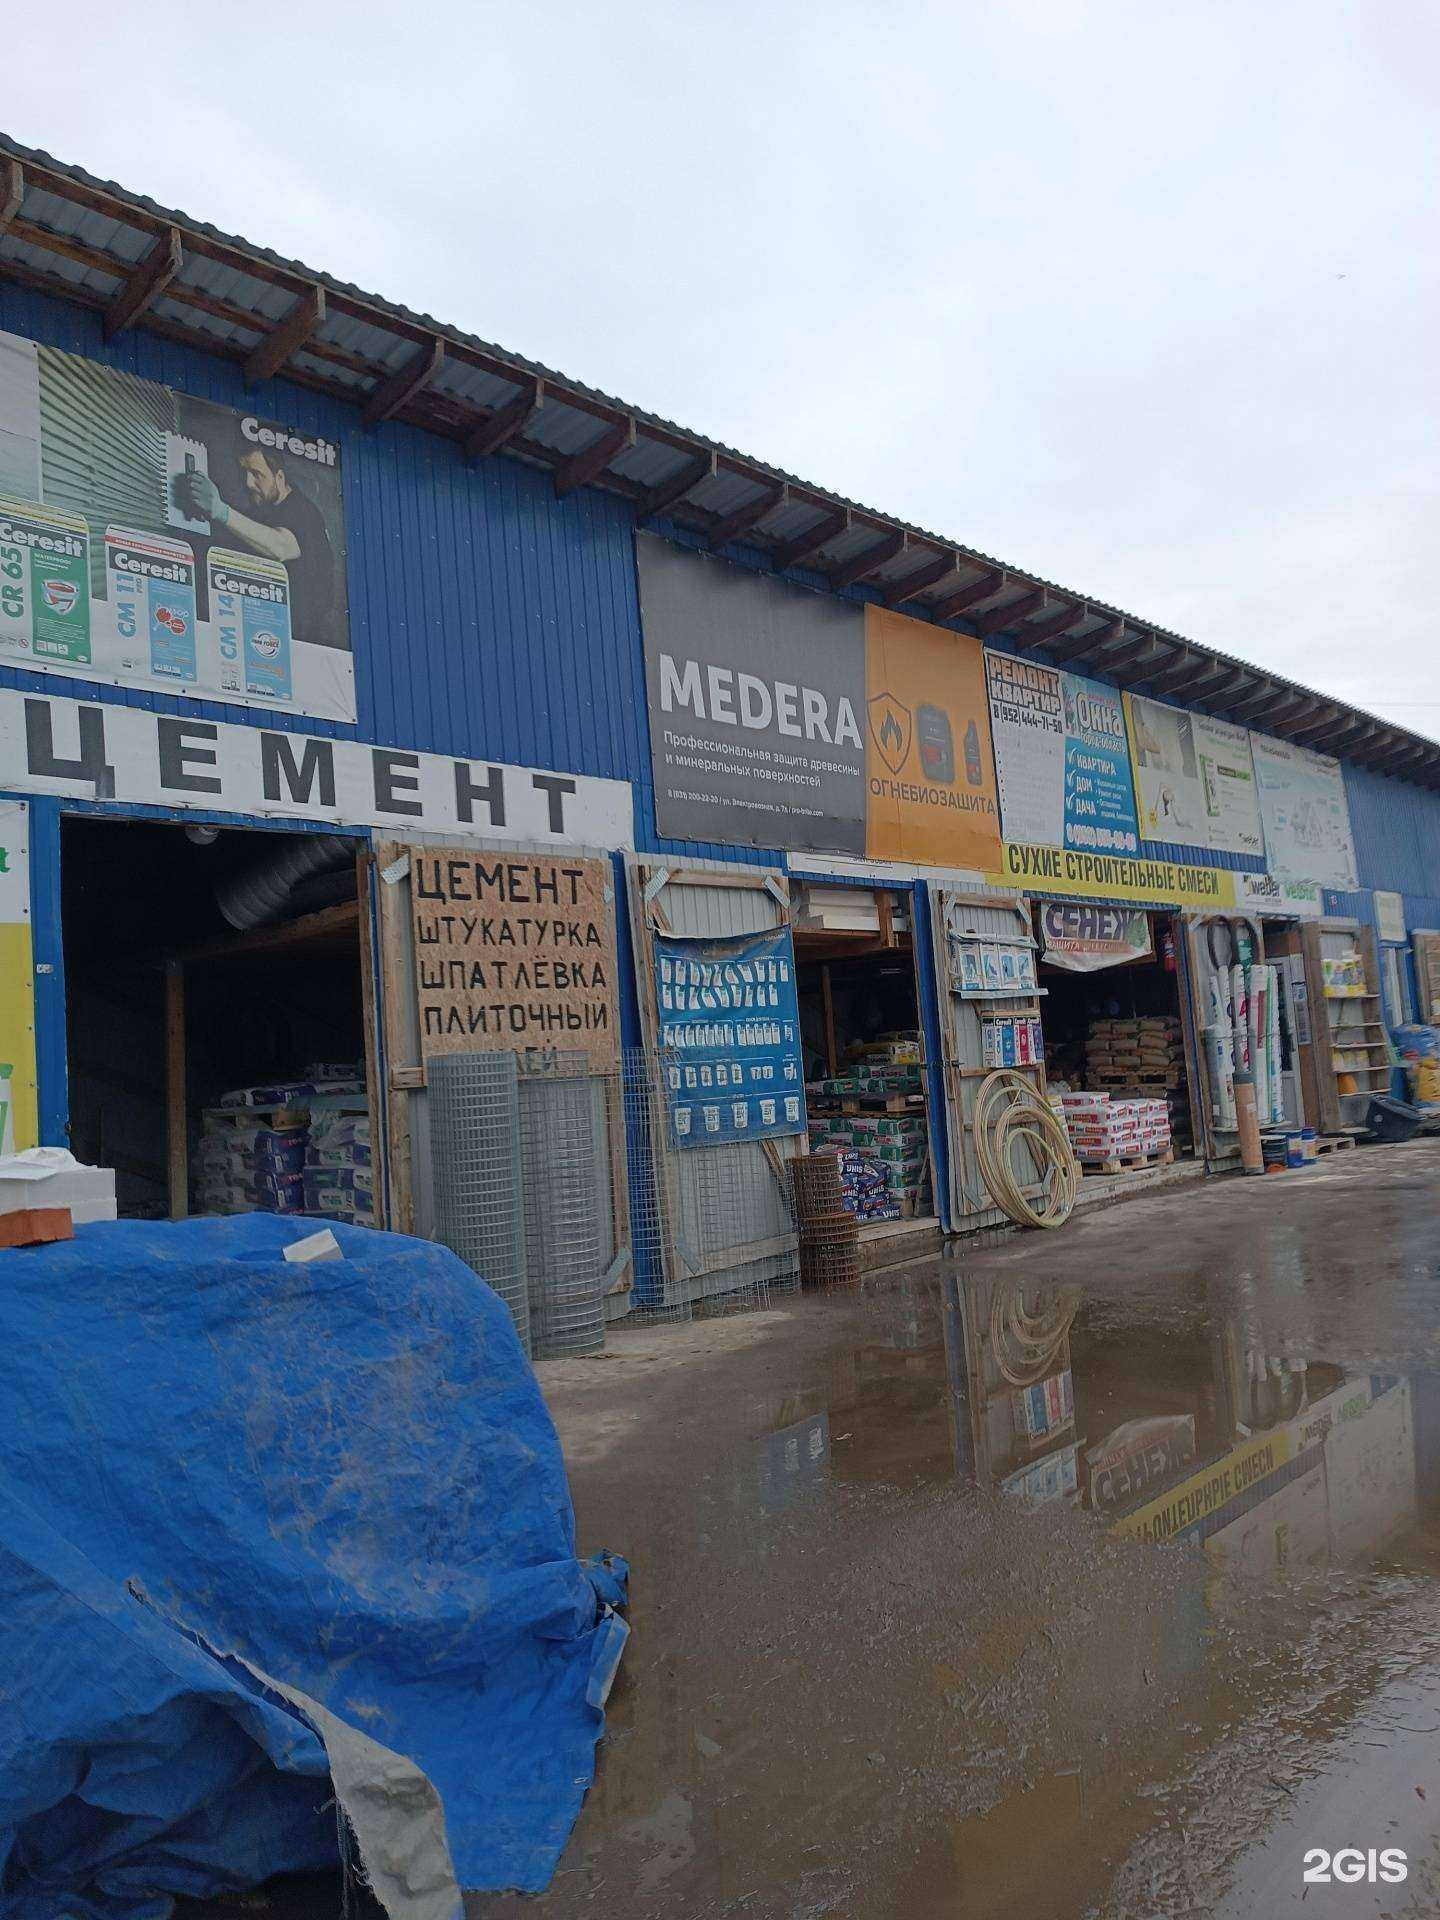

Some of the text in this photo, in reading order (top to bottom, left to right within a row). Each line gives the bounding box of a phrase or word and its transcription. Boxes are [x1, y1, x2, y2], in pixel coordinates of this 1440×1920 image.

[240, 416, 337, 467] Ceresit
[0, 522, 83, 557] Ceresit
[0, 547, 25, 618] CR 65
[114, 552, 188, 583] Ceresit
[116, 573, 135, 593] 11
[214, 573, 285, 603] Ceresit
[116, 602, 137, 638] CM
[217, 594, 238, 660] CM 14
[988, 654, 1060, 694] РЕМОНТ
[660, 653, 864, 750] MEDERA
[991, 680, 1061, 714] КВАРТИР
[24, 697, 577, 834] ЦЕМЕНТ
[664, 730, 860, 776] Профессиональная защита древесины
[666, 754, 821, 787] и минеральных поверхностей
[870, 778, 996, 815] ОГНЕБИОЗАЩИТА
[1076, 776, 1093, 793] ДОМ
[1075, 799, 1097, 815] ДАЧА
[416, 858, 584, 905] ЦЕМЕНТ
[1008, 844, 1219, 895] СУХИЕ СТРОИТЕЛЬНЫЕ СМЕСИ
[417, 916, 602, 948] ШТУКАТУРКА
[420, 955, 607, 990] ШПАТЛЁВКА
[424, 996, 608, 1035] ПЛИТОЧНЫЙ
[846, 1164, 864, 1174] UNIS
[882, 1209, 900, 1219] UNIS
